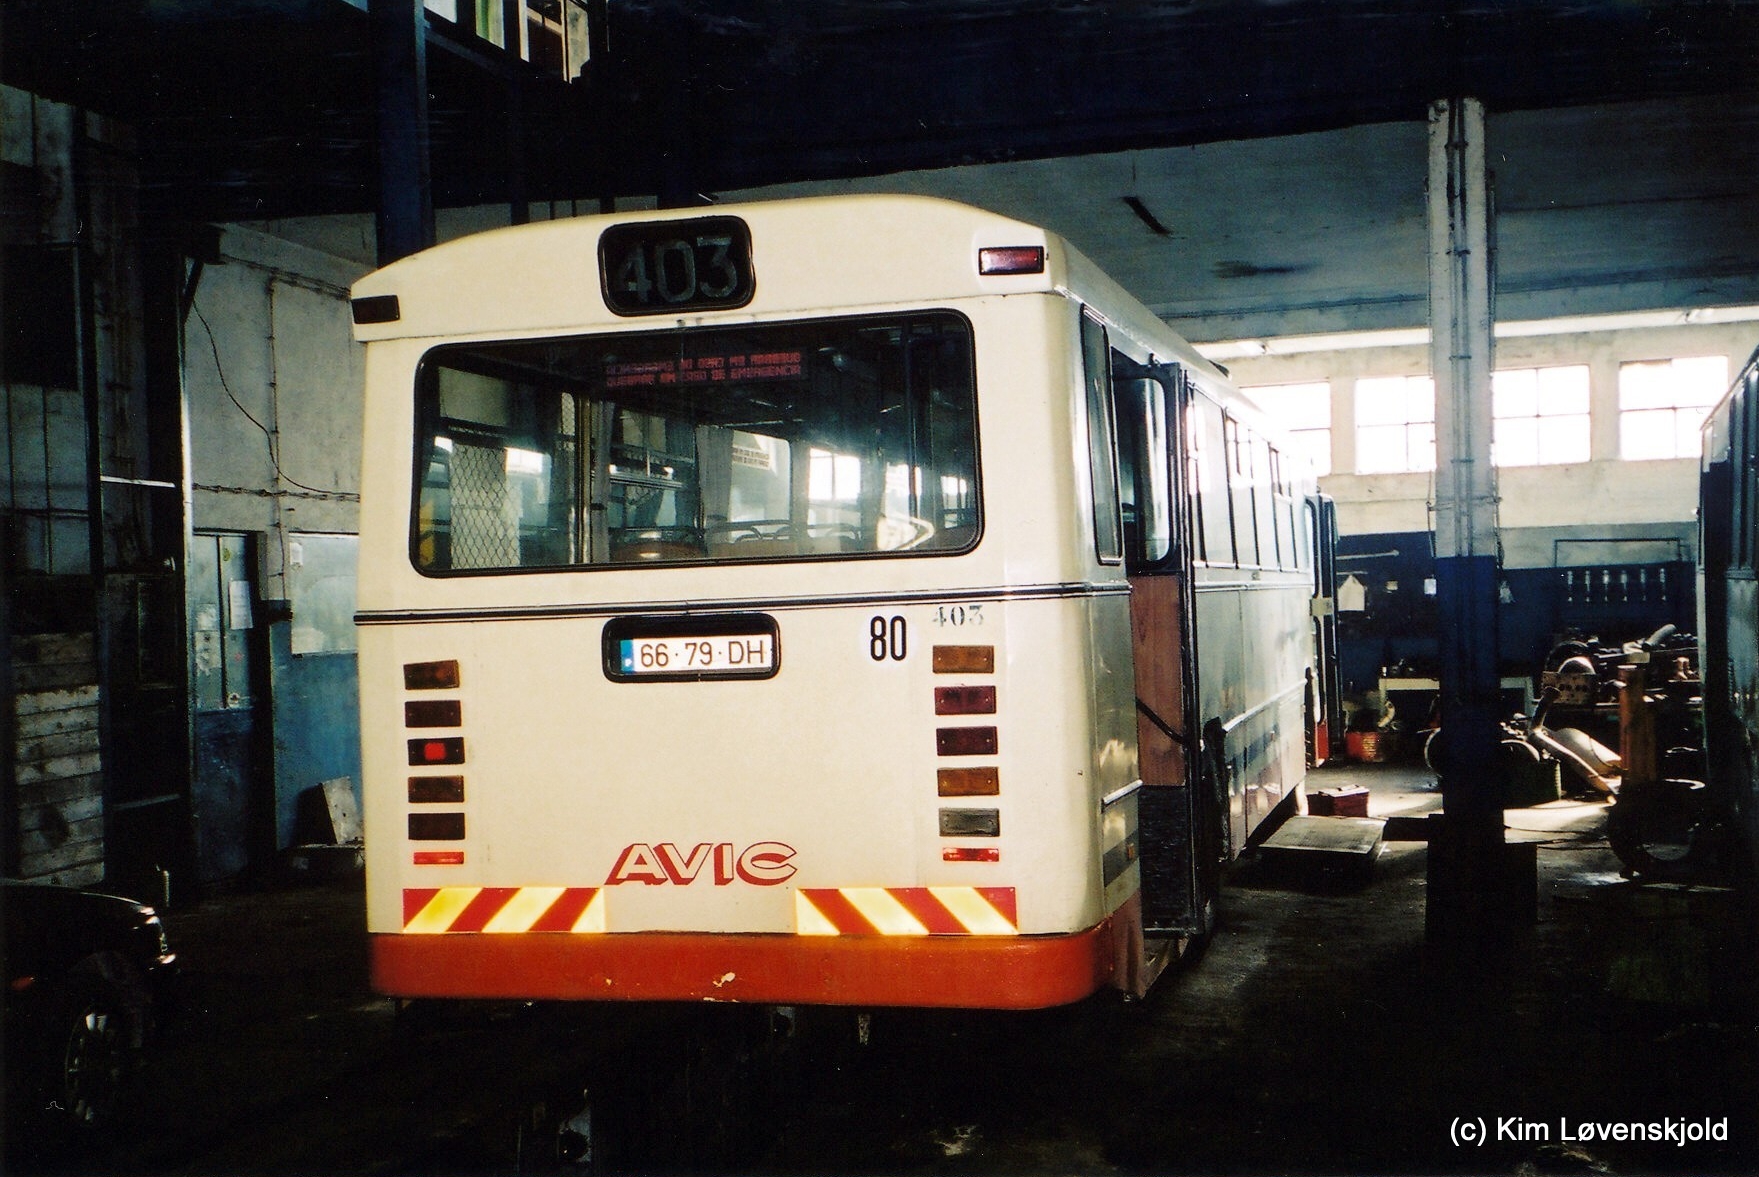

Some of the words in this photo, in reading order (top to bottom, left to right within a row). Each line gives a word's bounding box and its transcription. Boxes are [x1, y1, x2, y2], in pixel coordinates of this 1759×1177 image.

[614, 235, 738, 301] 403
[870, 615, 907, 661] 80
[933, 605, 984, 627] 403
[604, 841, 798, 886] AVIC
